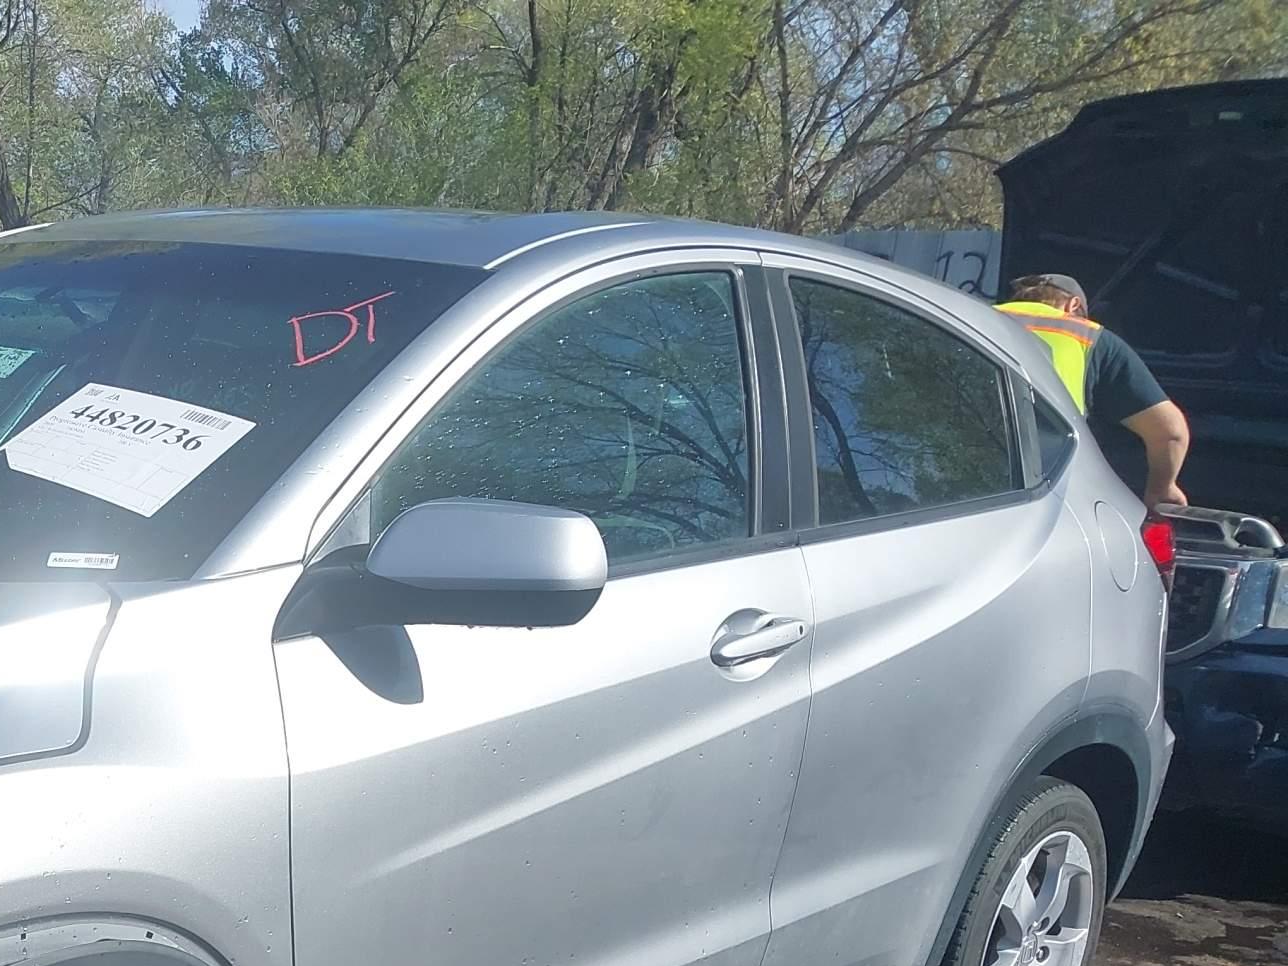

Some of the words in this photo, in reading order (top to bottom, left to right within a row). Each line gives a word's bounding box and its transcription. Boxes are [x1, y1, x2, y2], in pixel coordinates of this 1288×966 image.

[936, 251, 997, 299] 12
[287, 291, 395, 368] DT
[70, 404, 212, 451] 44820736
